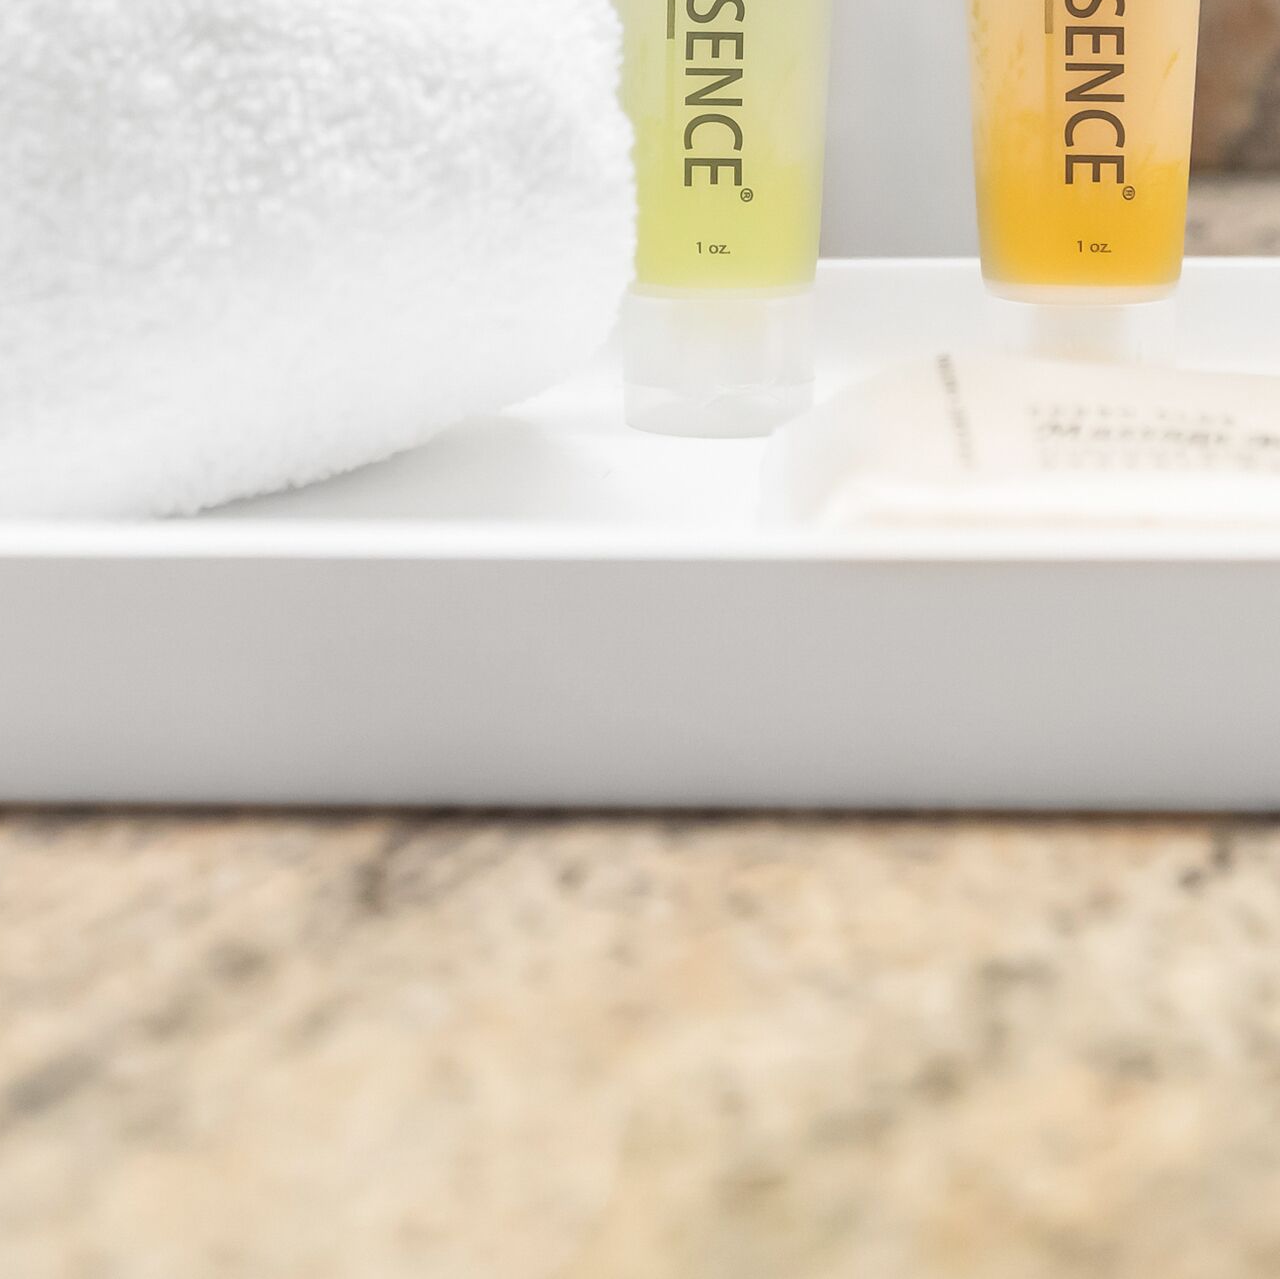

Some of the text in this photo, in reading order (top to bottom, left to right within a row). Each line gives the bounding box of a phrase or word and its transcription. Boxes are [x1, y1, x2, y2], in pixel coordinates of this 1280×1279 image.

[695, 241, 731, 255] 1 oz.
[1076, 240, 1112, 253] 1 oz.
